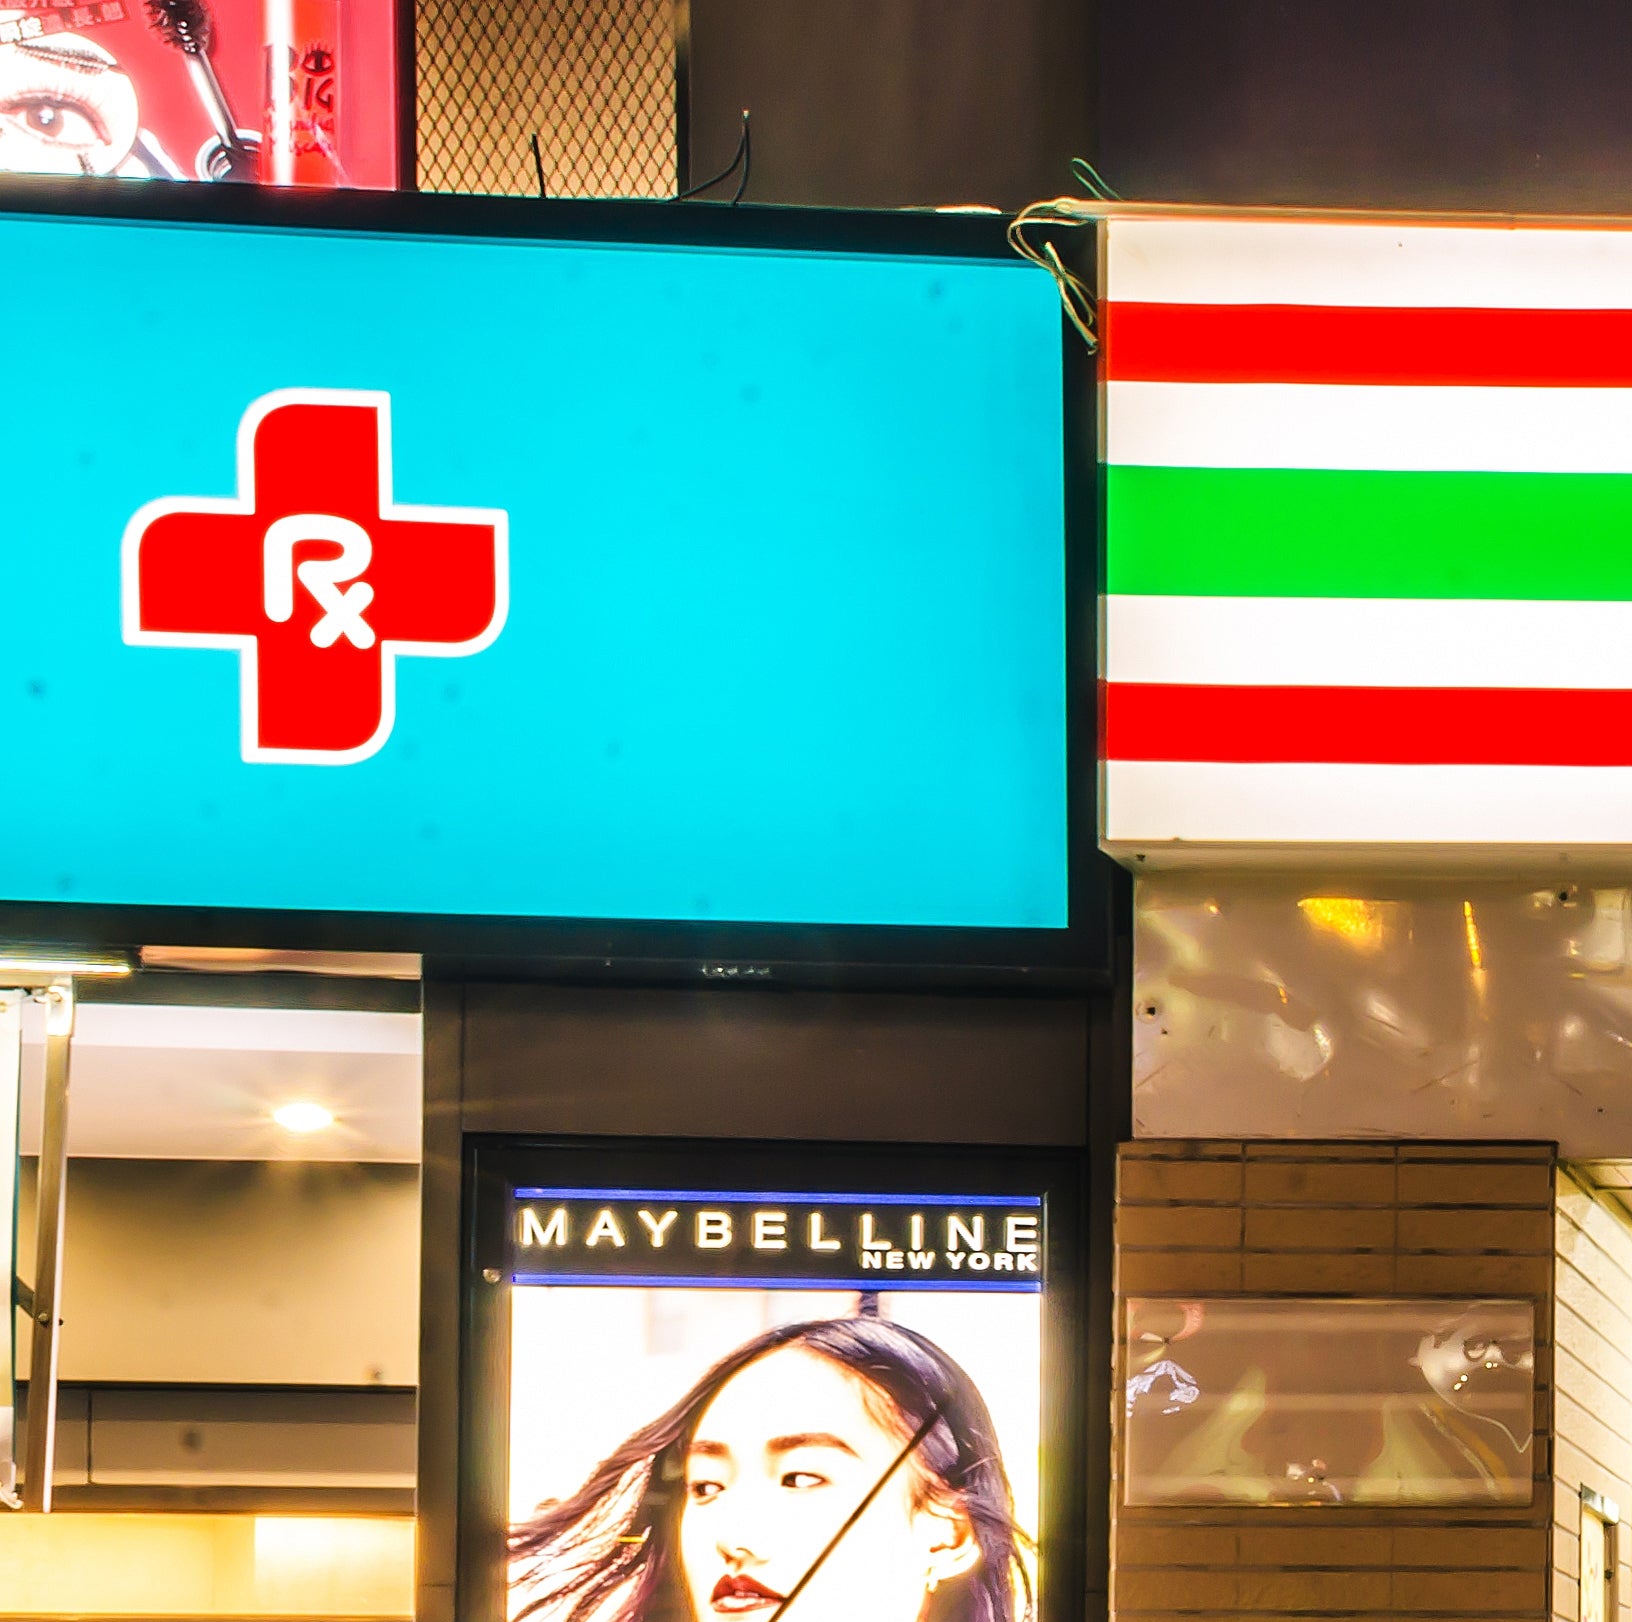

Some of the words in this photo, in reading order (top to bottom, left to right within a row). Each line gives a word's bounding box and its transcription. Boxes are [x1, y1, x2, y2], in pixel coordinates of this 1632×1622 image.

[263, 514, 376, 649] Rx
[520, 1206, 1039, 1253] MAYBELLINE
[862, 1250, 936, 1271] NEW
[945, 1251, 1038, 1272] YORK
